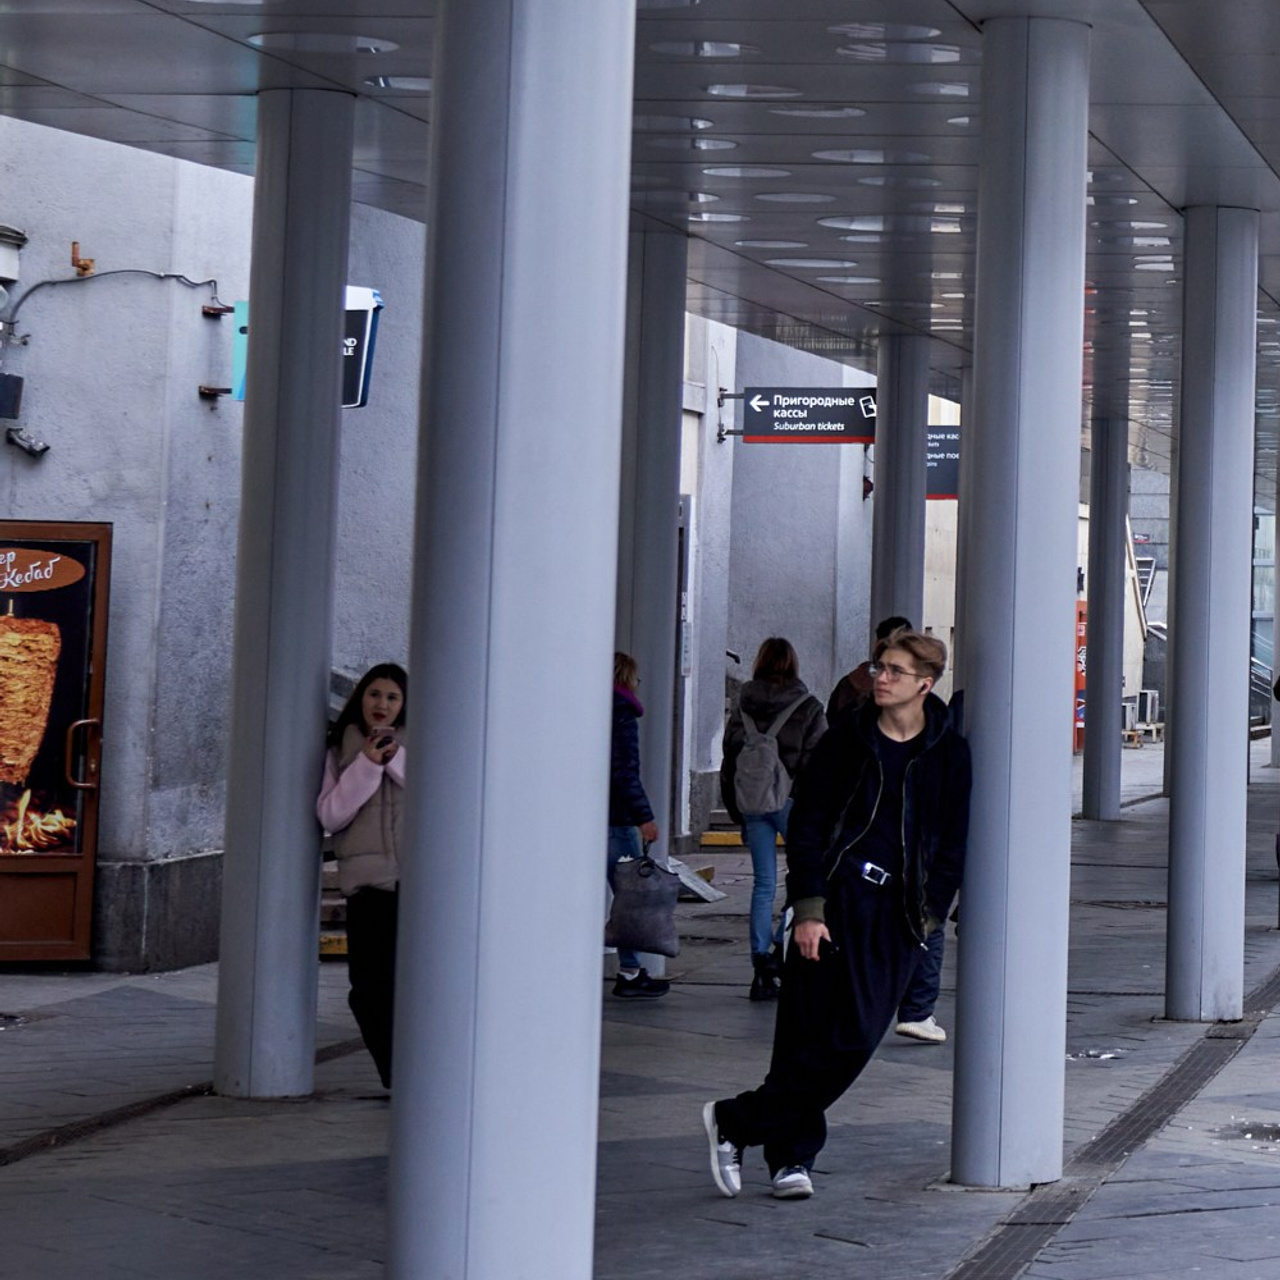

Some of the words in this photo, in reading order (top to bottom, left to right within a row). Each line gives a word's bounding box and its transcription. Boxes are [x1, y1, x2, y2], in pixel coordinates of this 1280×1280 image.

[773, 394, 856, 408] Пригородные
[773, 409, 808, 418] кассы
[773, 421, 816, 431] Suburban
[817, 422, 845, 431] tickets
